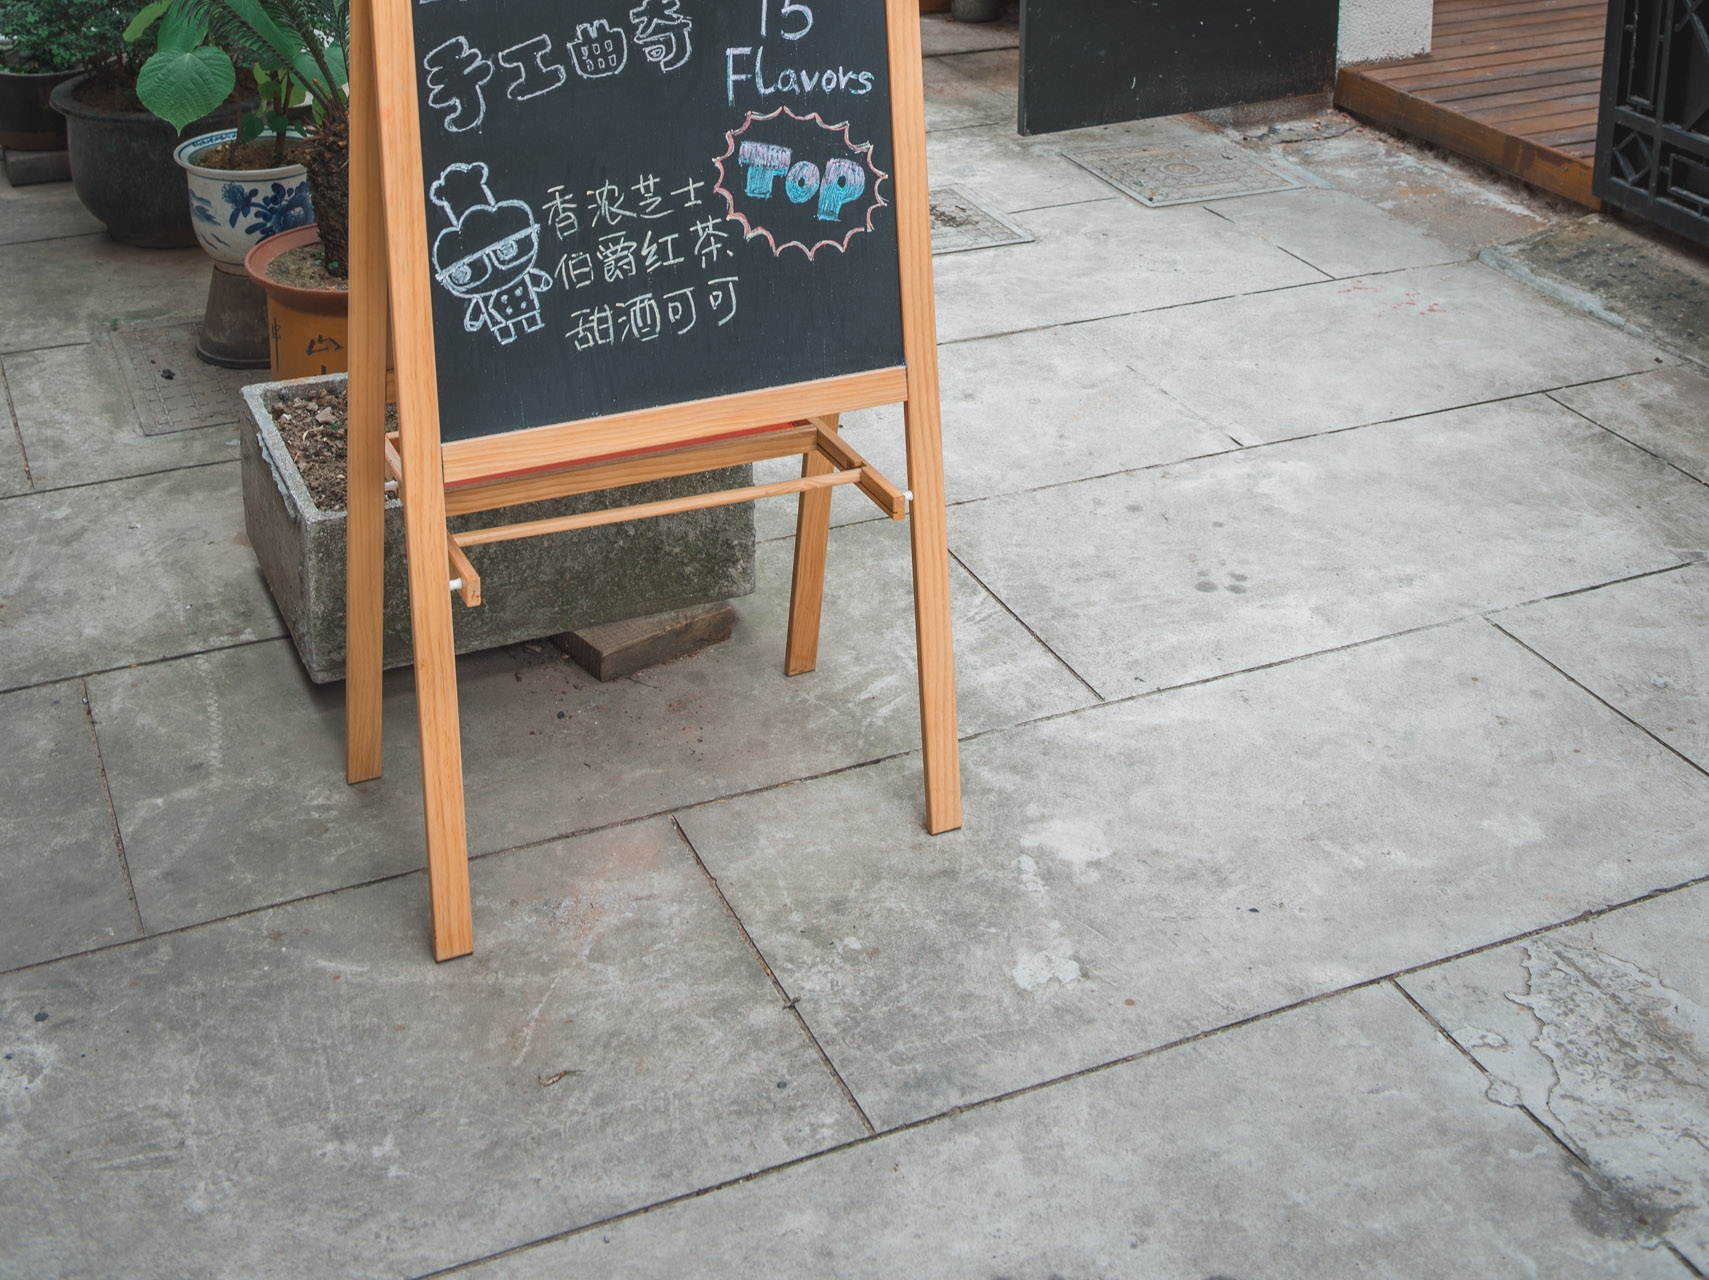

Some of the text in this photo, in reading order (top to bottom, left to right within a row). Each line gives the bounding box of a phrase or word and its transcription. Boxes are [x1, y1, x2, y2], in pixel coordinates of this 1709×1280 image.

[542, 173, 705, 241] 香浓芝士
[553, 215, 734, 292] 伯爵红茶
[566, 276, 739, 352] 甜酒可可
